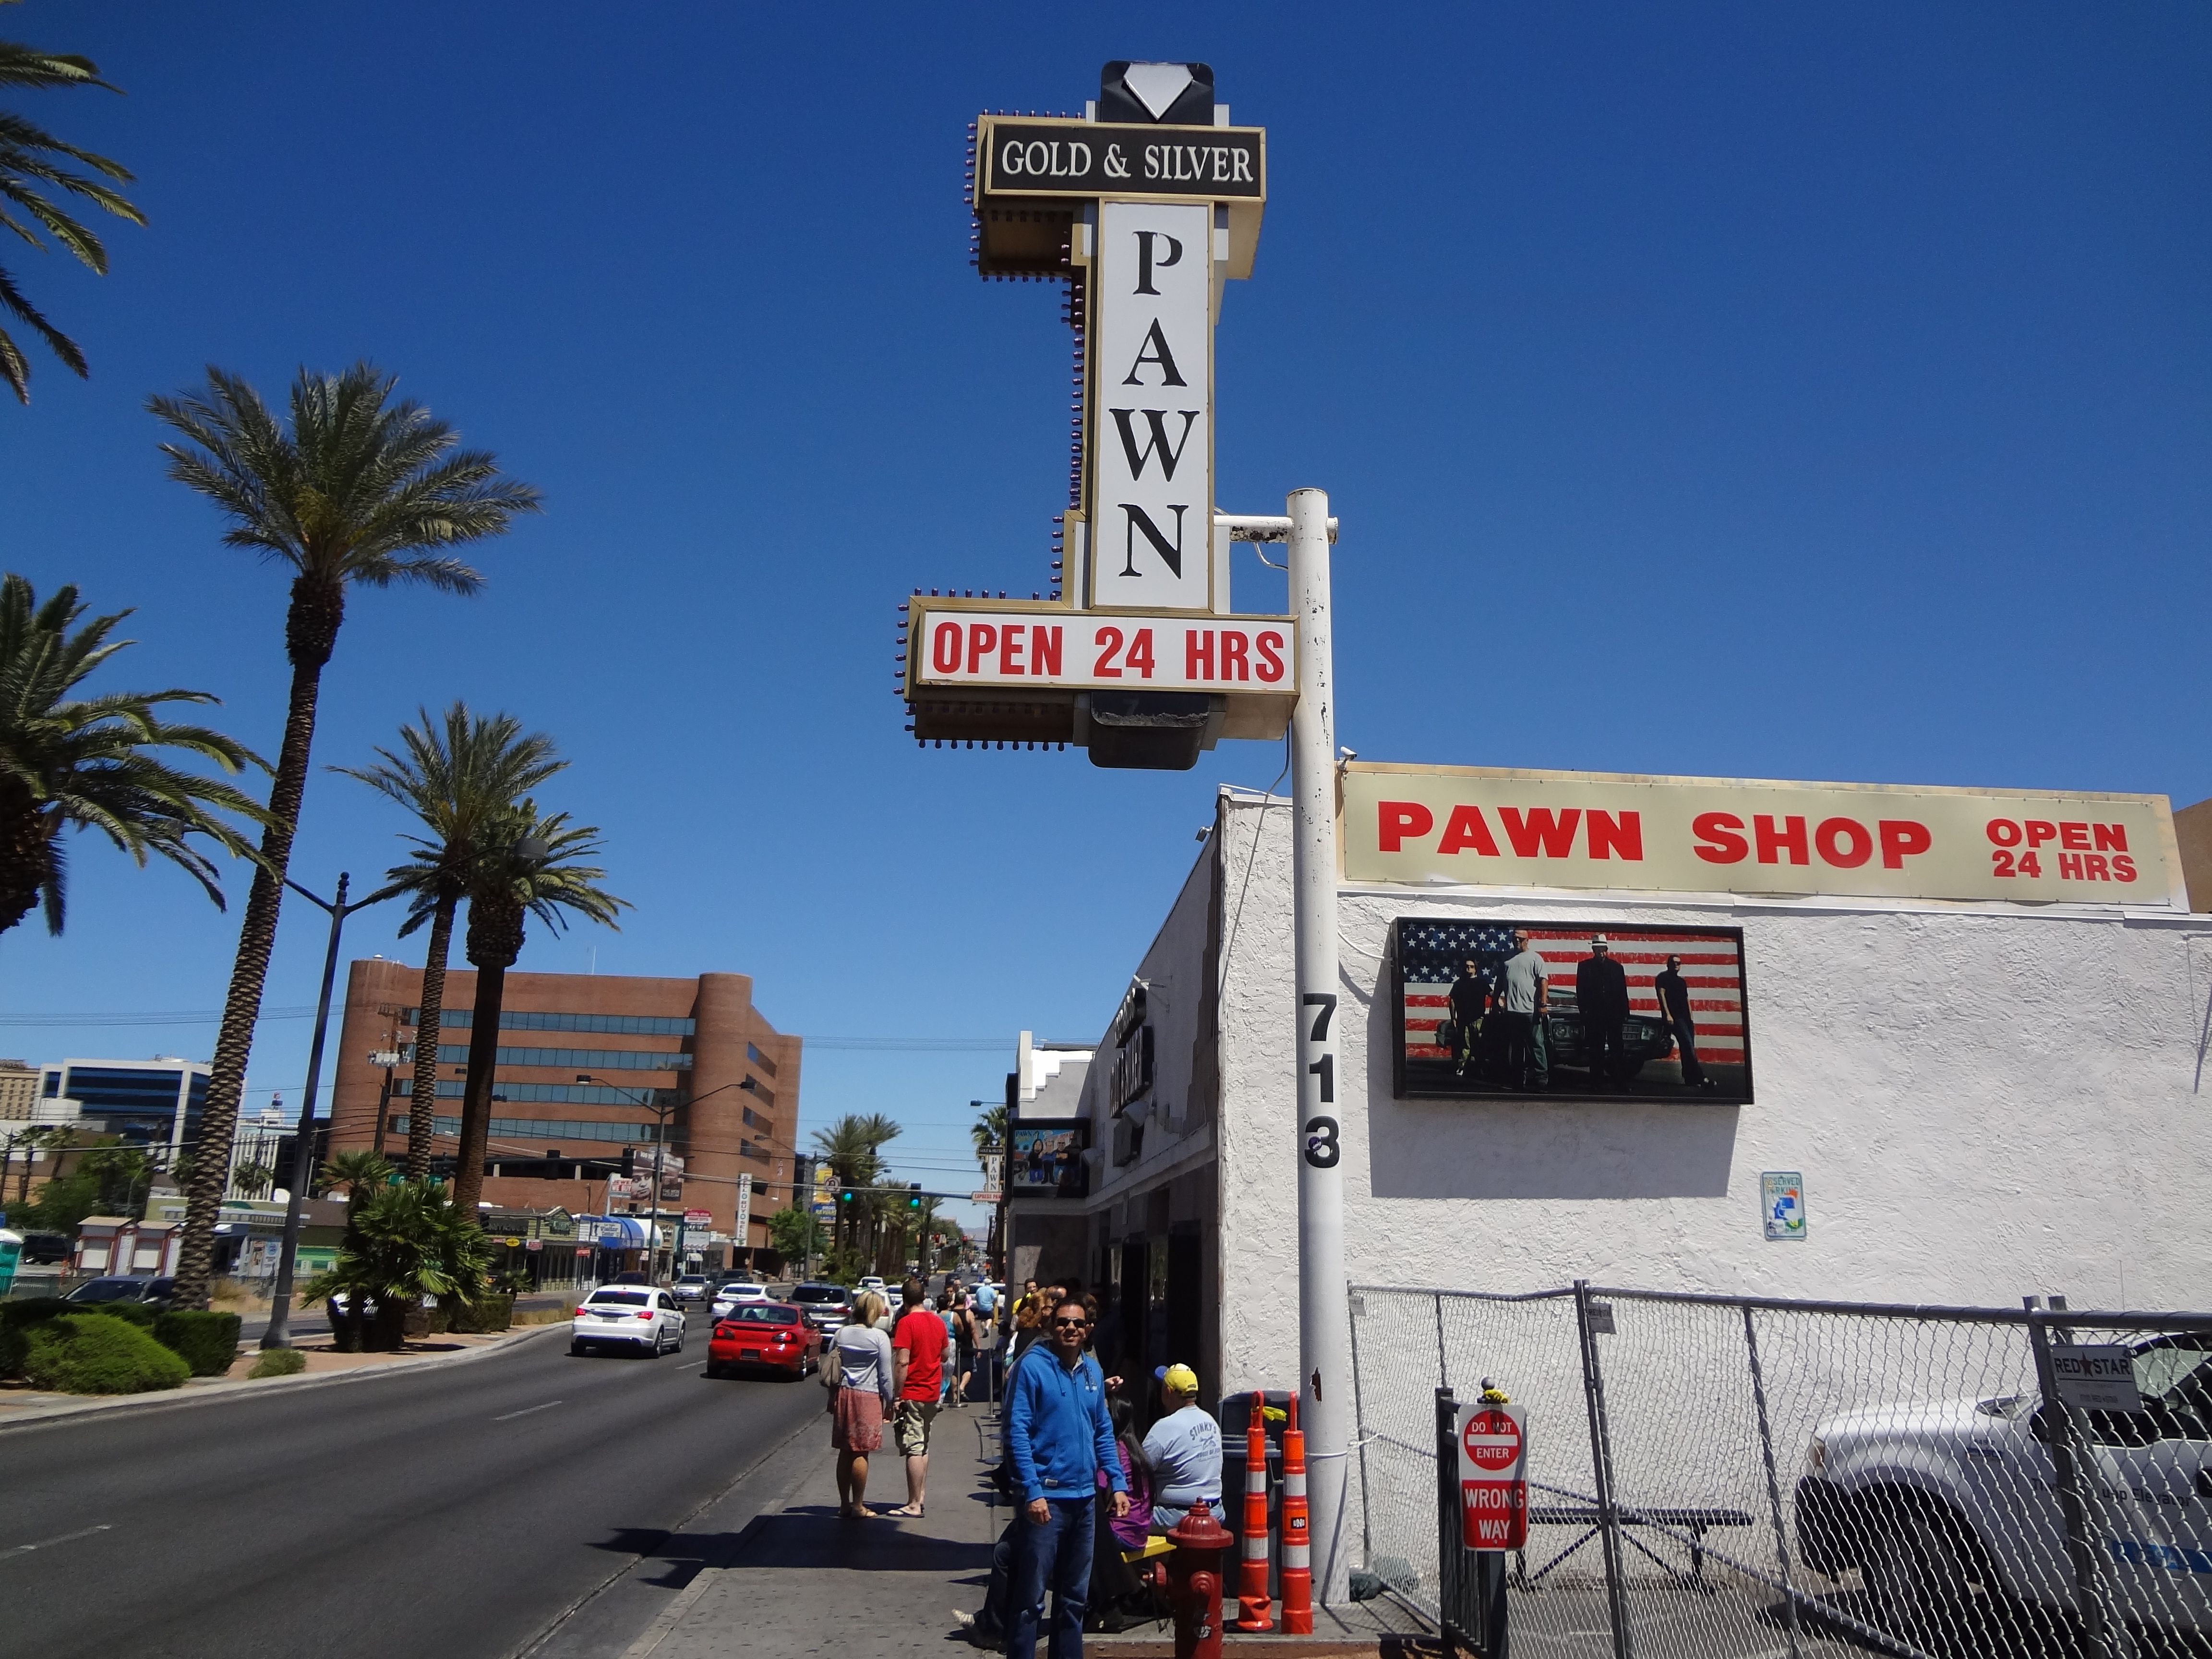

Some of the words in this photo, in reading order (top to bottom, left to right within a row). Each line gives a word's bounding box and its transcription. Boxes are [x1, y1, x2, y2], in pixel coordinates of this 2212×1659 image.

[1002, 140, 1092, 176] GOLD
[1104, 143, 1131, 178] &
[1145, 144, 1253, 182] SILVER
[1108, 231, 1200, 579] PAWN
[933, 621, 1063, 676] OPEN
[1093, 626, 1155, 679] 24
[1185, 630, 1284, 683] HRS
[1378, 801, 1644, 861] PAWN
[1692, 812, 1933, 869] SHOP
[1986, 818, 2129, 852] OPEN
[1992, 849, 2042, 878] 24
[2057, 852, 2138, 883] HRS
[1303, 992, 1341, 1168] 713
[989, 1157, 998, 1190] PAWN
[2054, 1358, 2081, 1373] RED
[2092, 1358, 2132, 1374] STAR
[1472, 1422, 1486, 1433] DO
[1493, 1422, 1512, 1433] NOT
[1477, 1448, 1509, 1458] ENTER
[1465, 1489, 1524, 1509] WRONG
[1479, 1519, 1510, 1539] WAY
